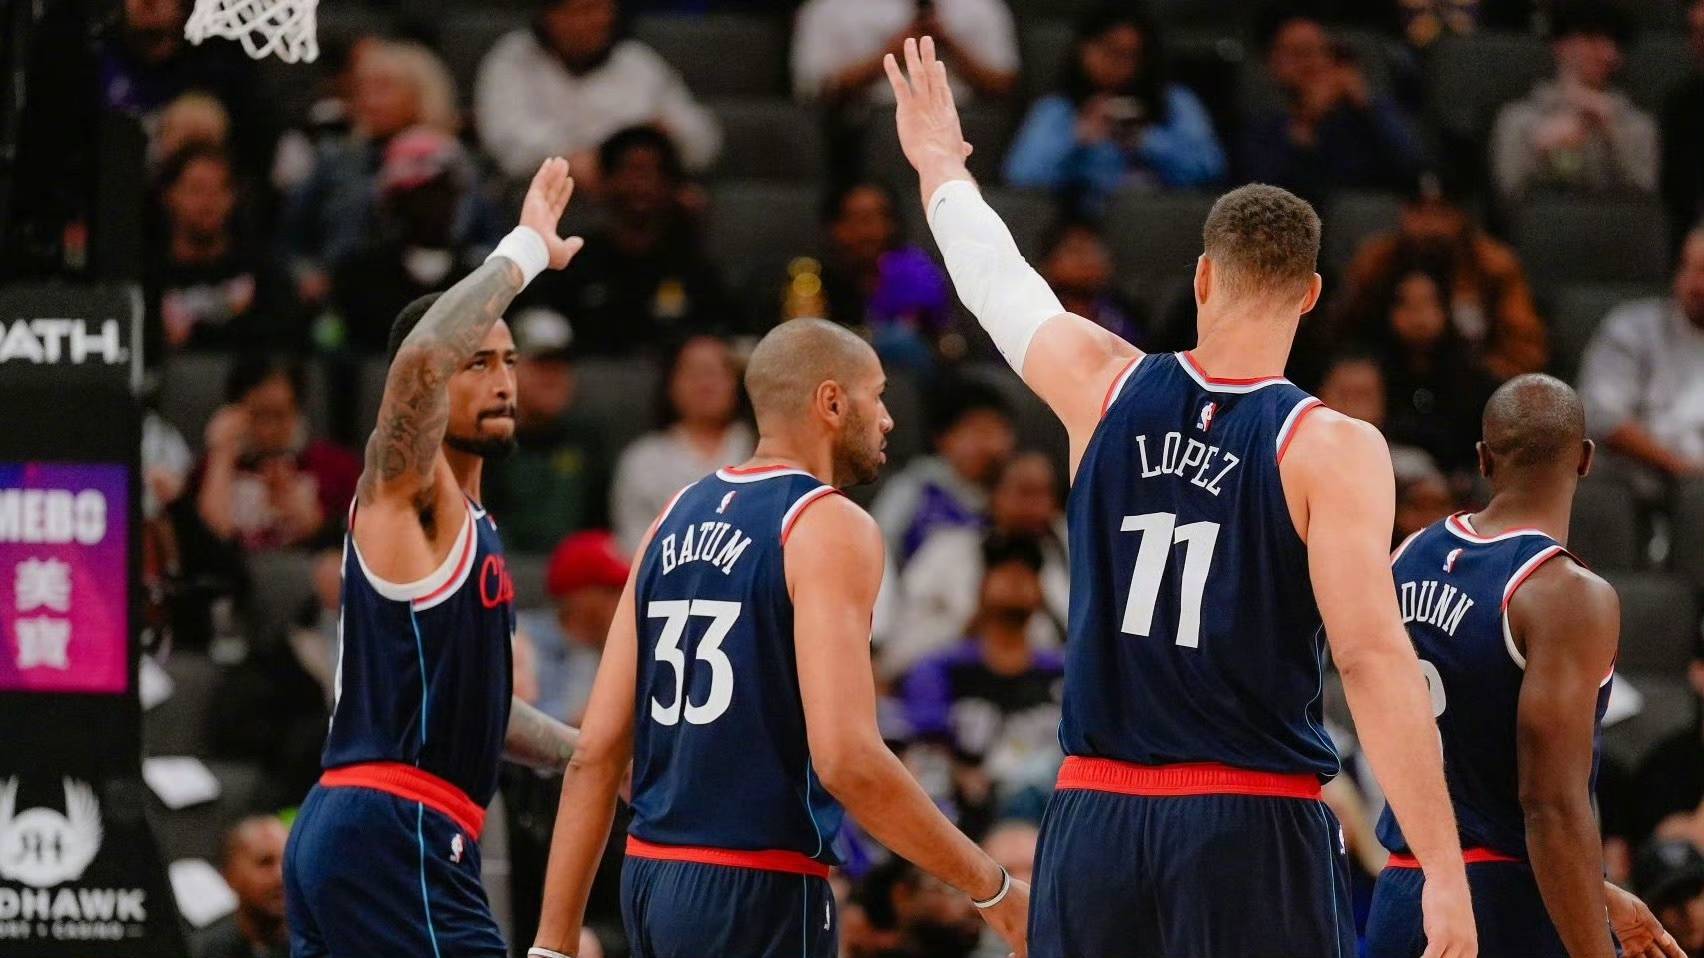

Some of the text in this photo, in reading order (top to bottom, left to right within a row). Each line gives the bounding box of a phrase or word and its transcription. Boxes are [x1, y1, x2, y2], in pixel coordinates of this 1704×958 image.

[1136, 432, 1240, 496] LOPEZ
[662, 521, 752, 576] BATUM
[1120, 512, 1220, 648] 11
[1401, 580, 1474, 637] DUNN
[647, 599, 742, 726] 33
